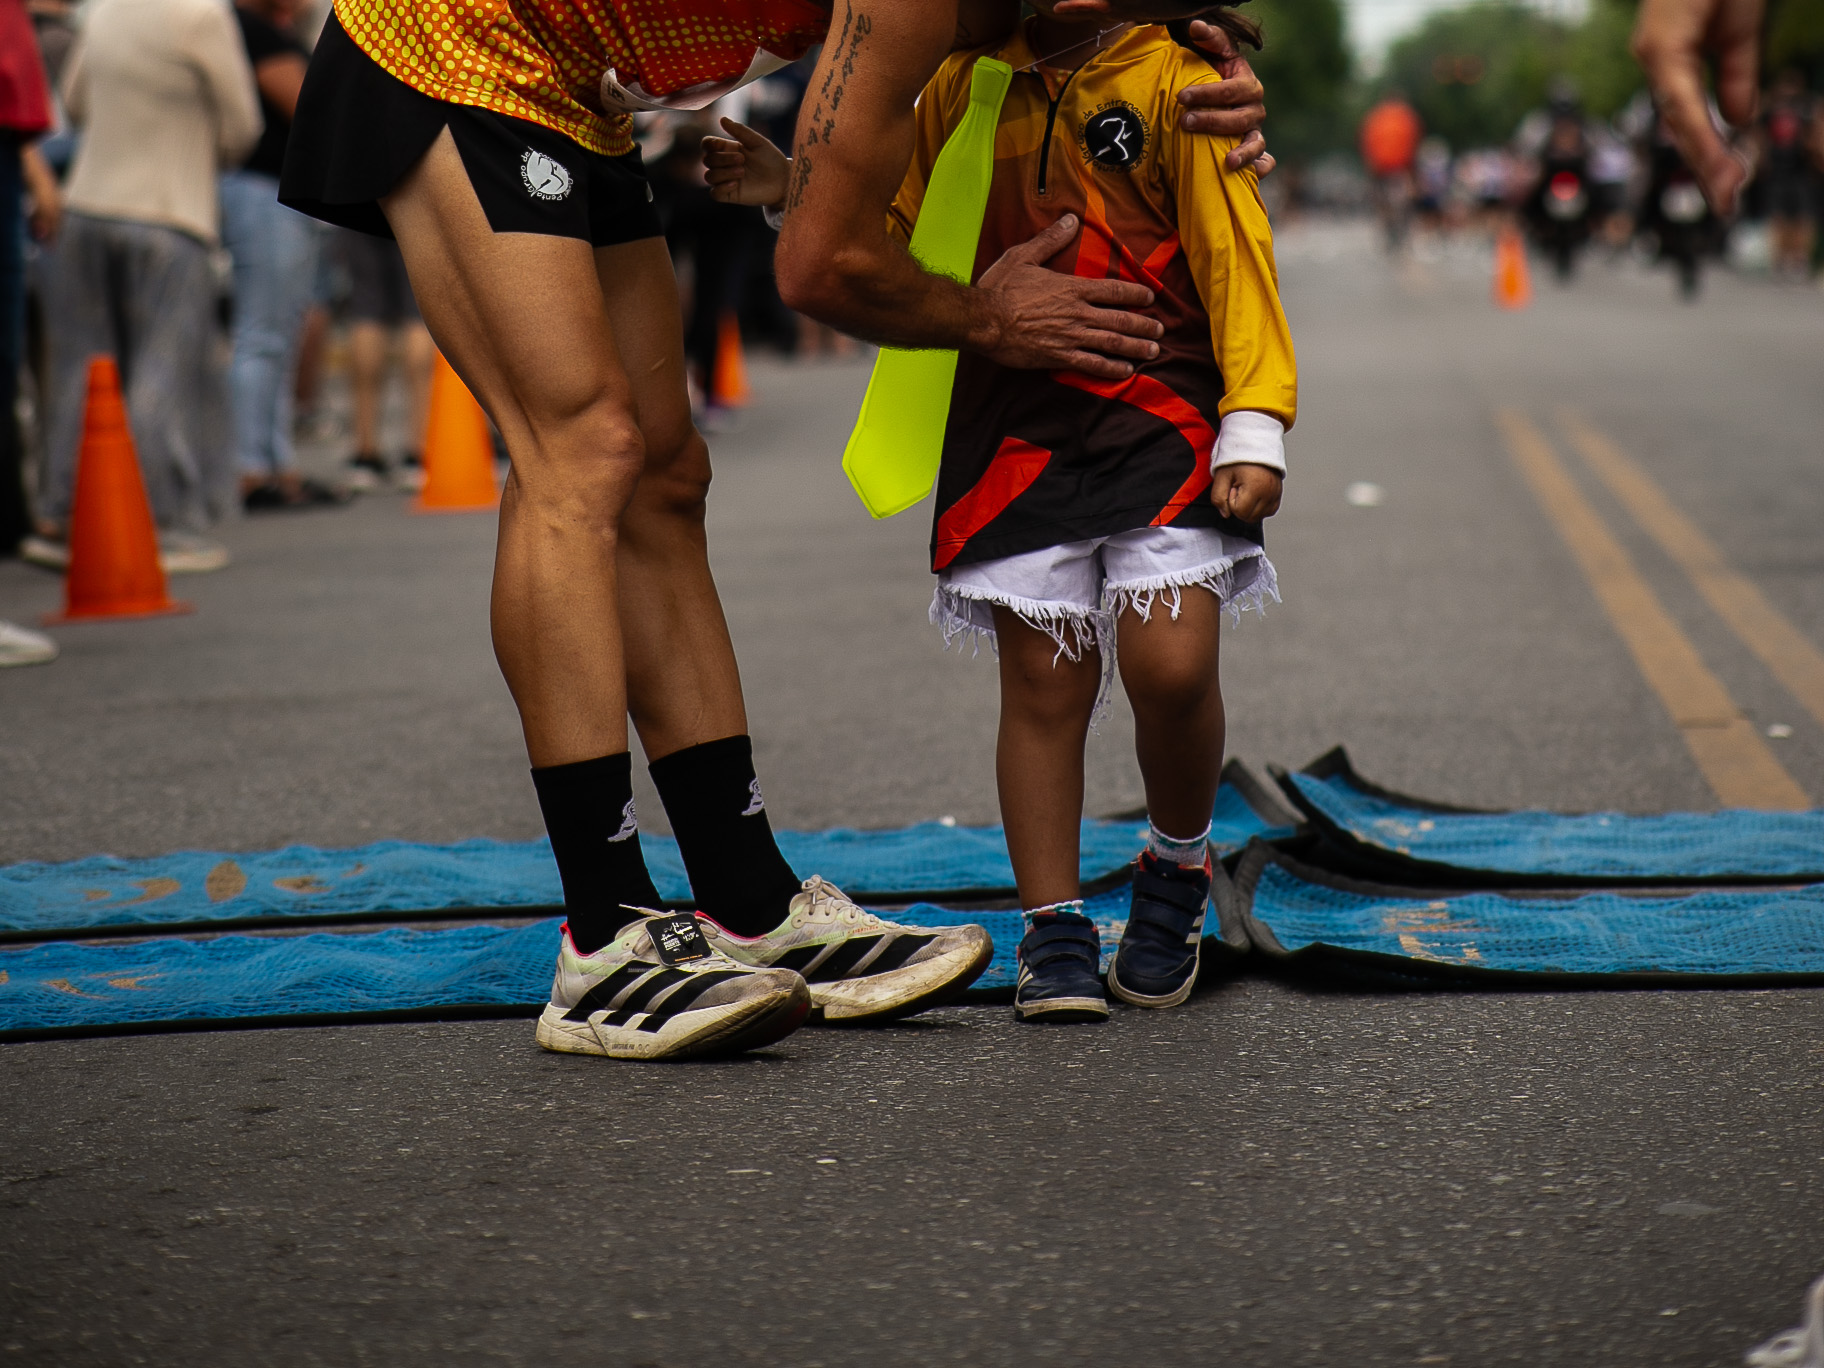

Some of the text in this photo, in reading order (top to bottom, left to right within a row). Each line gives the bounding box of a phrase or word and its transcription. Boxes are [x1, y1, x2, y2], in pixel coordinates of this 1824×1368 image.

[1082, 110, 1095, 121] de
[520, 151, 531, 163] de
[521, 165, 534, 193] Grupo
[536, 192, 562, 200] Penta
